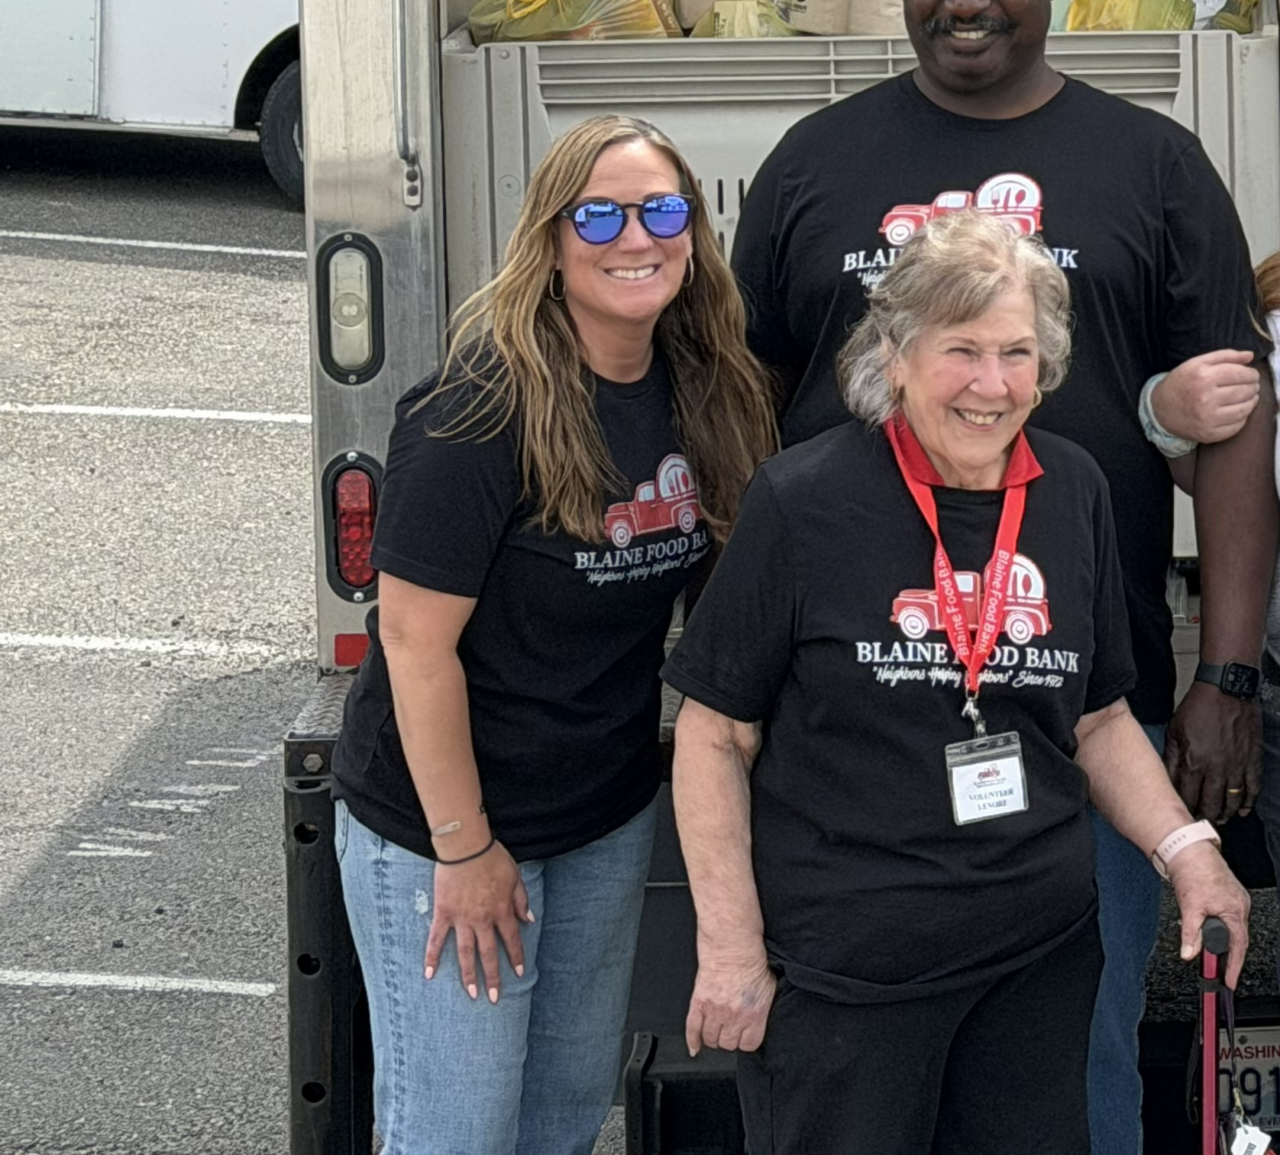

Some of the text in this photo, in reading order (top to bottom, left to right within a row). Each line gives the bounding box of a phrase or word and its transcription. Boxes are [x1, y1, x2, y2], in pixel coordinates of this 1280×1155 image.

[574, 546, 644, 569] BLAINE
[645, 536, 689, 562] FOOD
[855, 641, 948, 664] BLAINE
[1024, 647, 1080, 674] BANK
